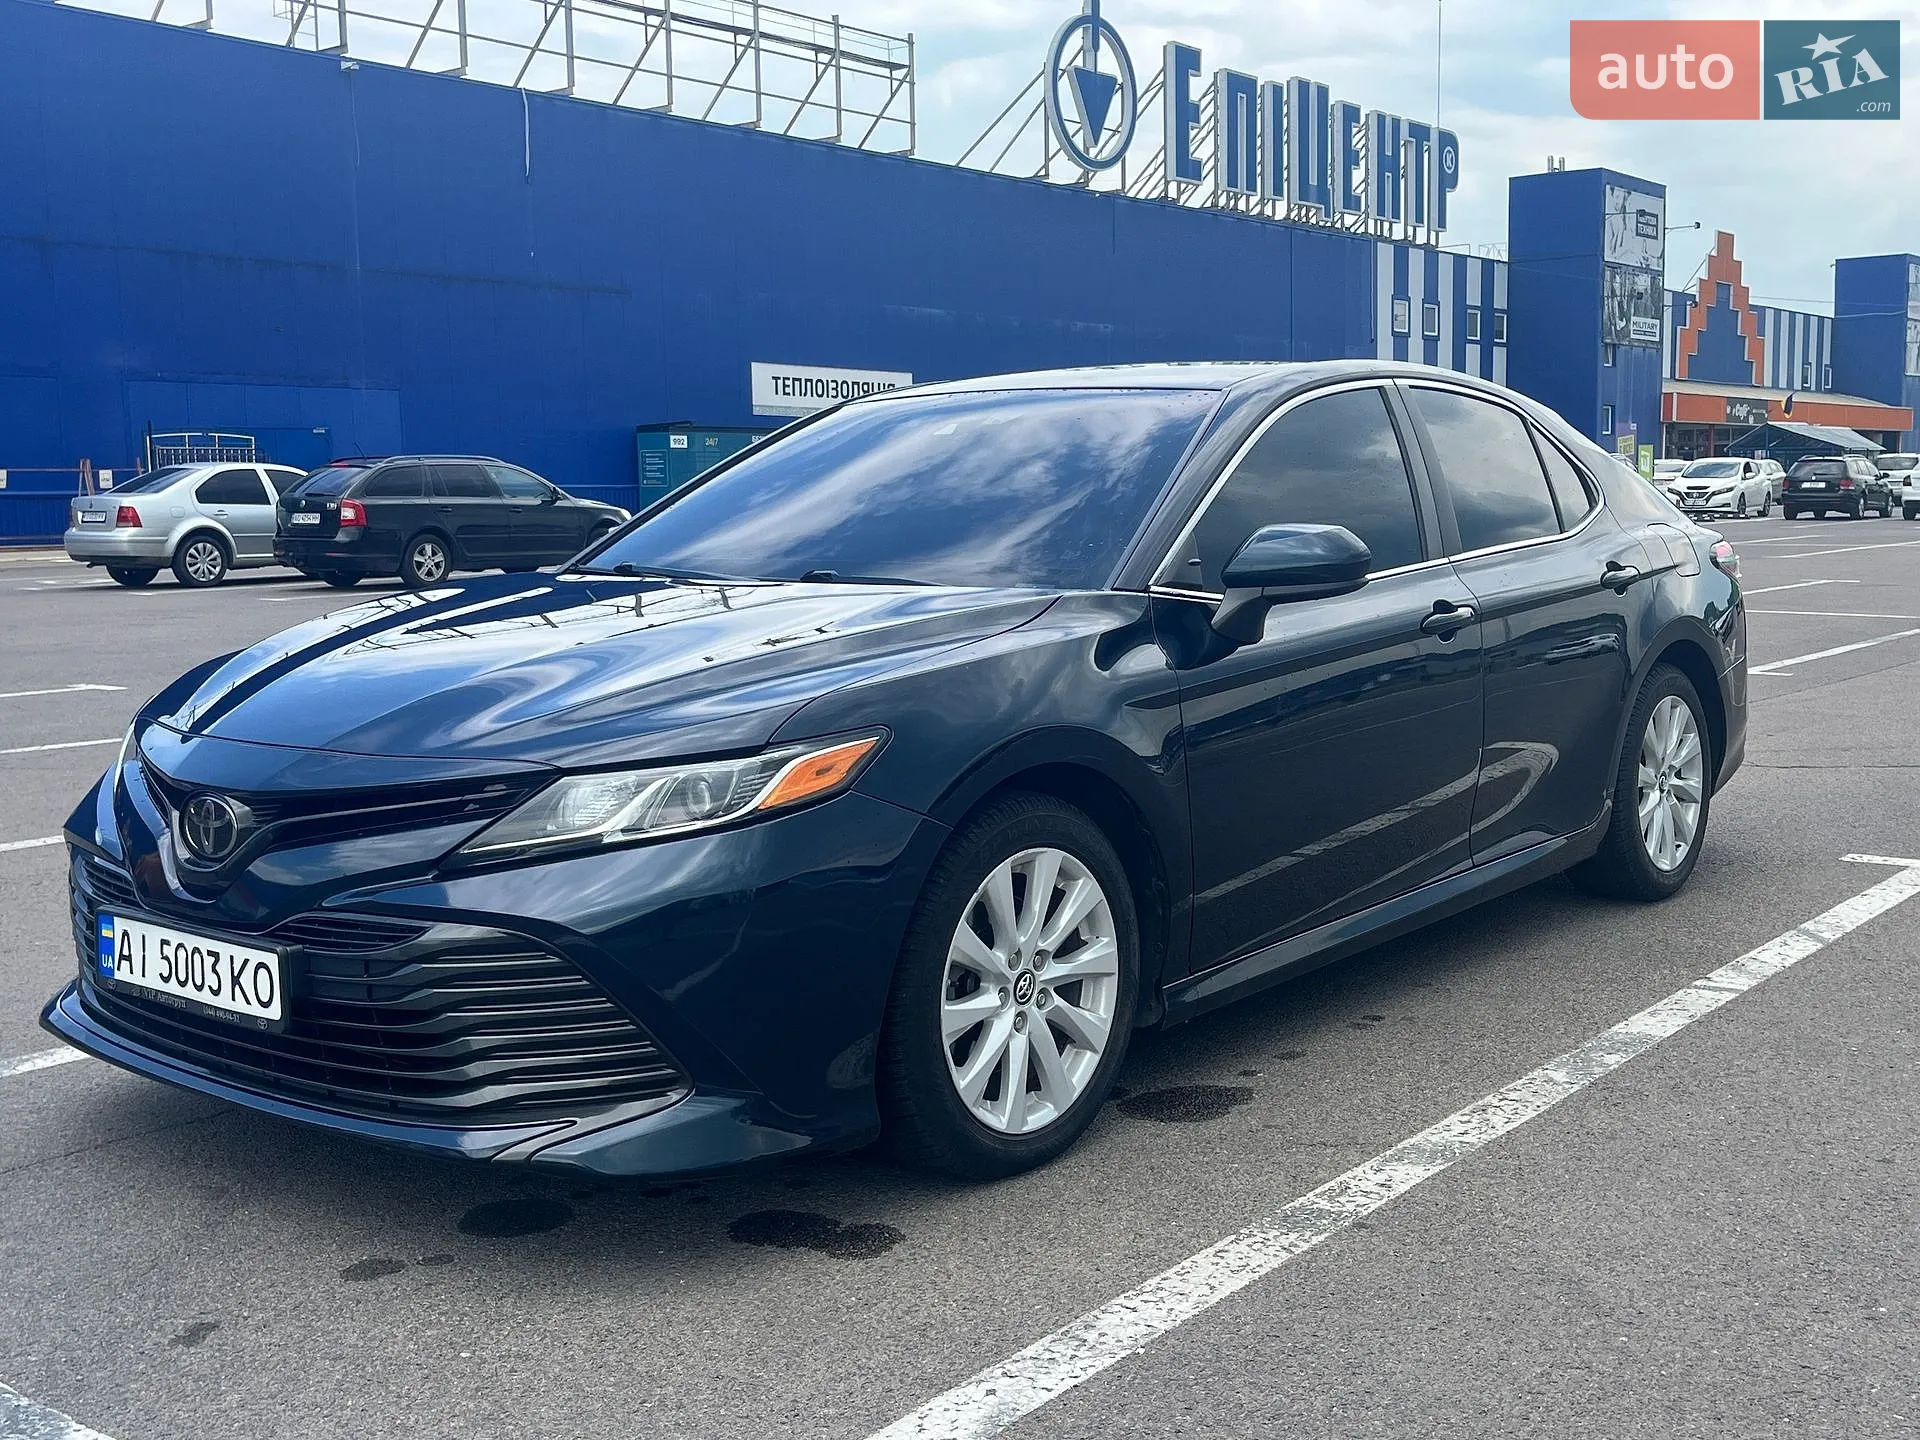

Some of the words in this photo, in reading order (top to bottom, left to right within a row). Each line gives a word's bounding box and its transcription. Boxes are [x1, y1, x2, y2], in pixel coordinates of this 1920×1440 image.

[1163, 40, 1459, 232] ЕПІЦЕНТР
[672, 438, 685, 446] 992
[705, 437, 718, 447] 24/7
[102, 954, 114, 968] UA
[117, 929, 147, 978] AI
[159, 938, 222, 997] 5003
[229, 954, 275, 1009] KO
